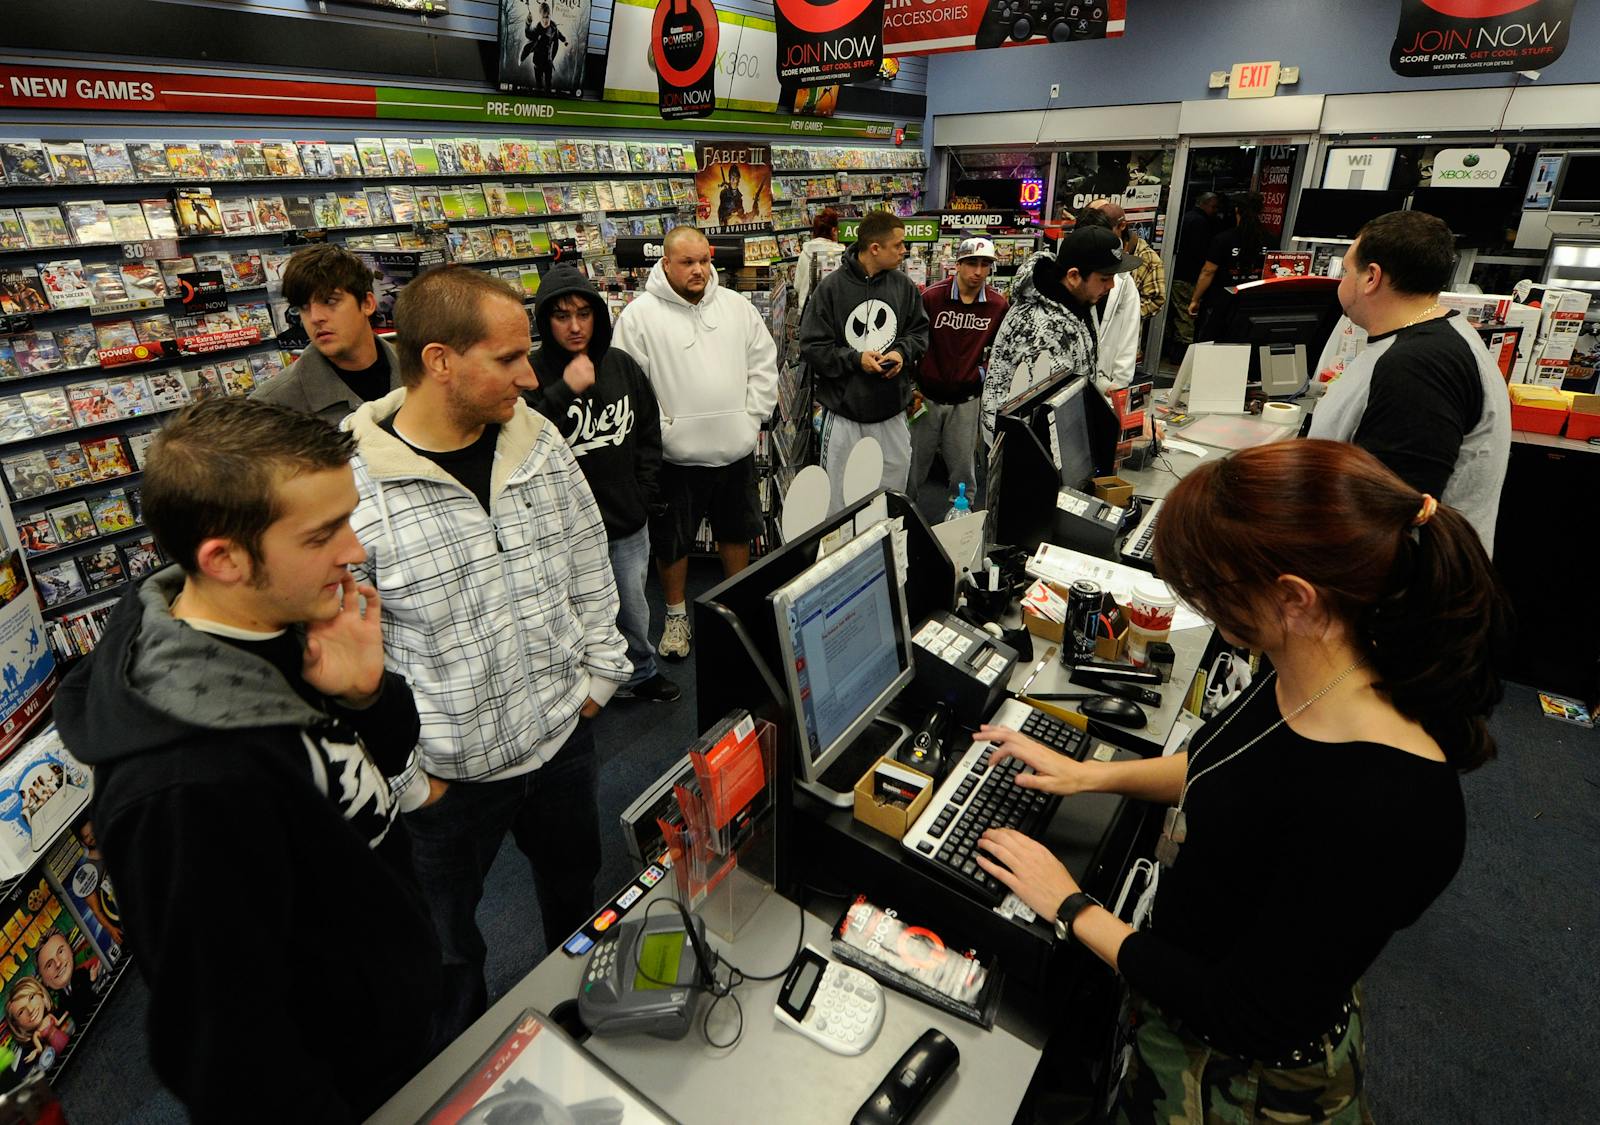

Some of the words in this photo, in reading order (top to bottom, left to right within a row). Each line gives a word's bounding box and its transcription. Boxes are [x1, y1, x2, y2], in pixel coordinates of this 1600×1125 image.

[884, 5, 968, 28] ACCESSORIES
[1403, 28, 1473, 53] JOIN
[1476, 20, 1562, 49] NOW
[782, 43, 821, 67] JOIN
[823, 35, 877, 62] NOW
[1400, 55, 1430, 63] SCORE
[1432, 53, 1468, 62] POINTS.
[1470, 51, 1488, 59] GET
[1491, 49, 1518, 58] COOL
[726, 52, 759, 78] 360
[781, 67, 799, 77] SCORE
[799, 65, 821, 75] POINTS.
[822, 63, 833, 72] GET
[834, 62, 851, 71] COOL
[1239, 64, 1272, 88] EXIT
[10, 76, 67, 98] NEW
[76, 79, 155, 101] GAMES
[683, 89, 712, 105] NOW
[487, 101, 554, 118] PRE-OWNED
[790, 120, 803, 130] NEW
[804, 121, 824, 131] GAMES
[866, 125, 876, 134] NEW
[877, 126, 892, 135] GAMES
[697, 147, 747, 172] FABLE
[747, 147, 767, 166] III
[1347, 154, 1372, 166] Wii
[1268, 174, 1288, 185] SANTA
[1438, 169, 1472, 180] XBOX
[1472, 169, 1498, 180] 360
[1267, 192, 1285, 205] EASY
[951, 202, 983, 210] WARCRAFT
[941, 214, 1003, 226] PRE-OWNED
[705, 227, 721, 236] NOW
[726, 223, 765, 233] AVAILABLE
[380, 255, 413, 263] HALO
[206, 301, 227, 310] NOW
[176, 320, 197, 328] MAFIA
[934, 311, 991, 330] Phillies
[196, 335, 213, 343] Extra
[214, 331, 239, 340] In-Store
[239, 328, 257, 336] Credit
[99, 347, 133, 360] power
[24, 698, 39, 717] Wii
[10, 889, 23, 901] Wii
[621, 890, 638, 906] VISA
[866, 907, 898, 951] SCORE
